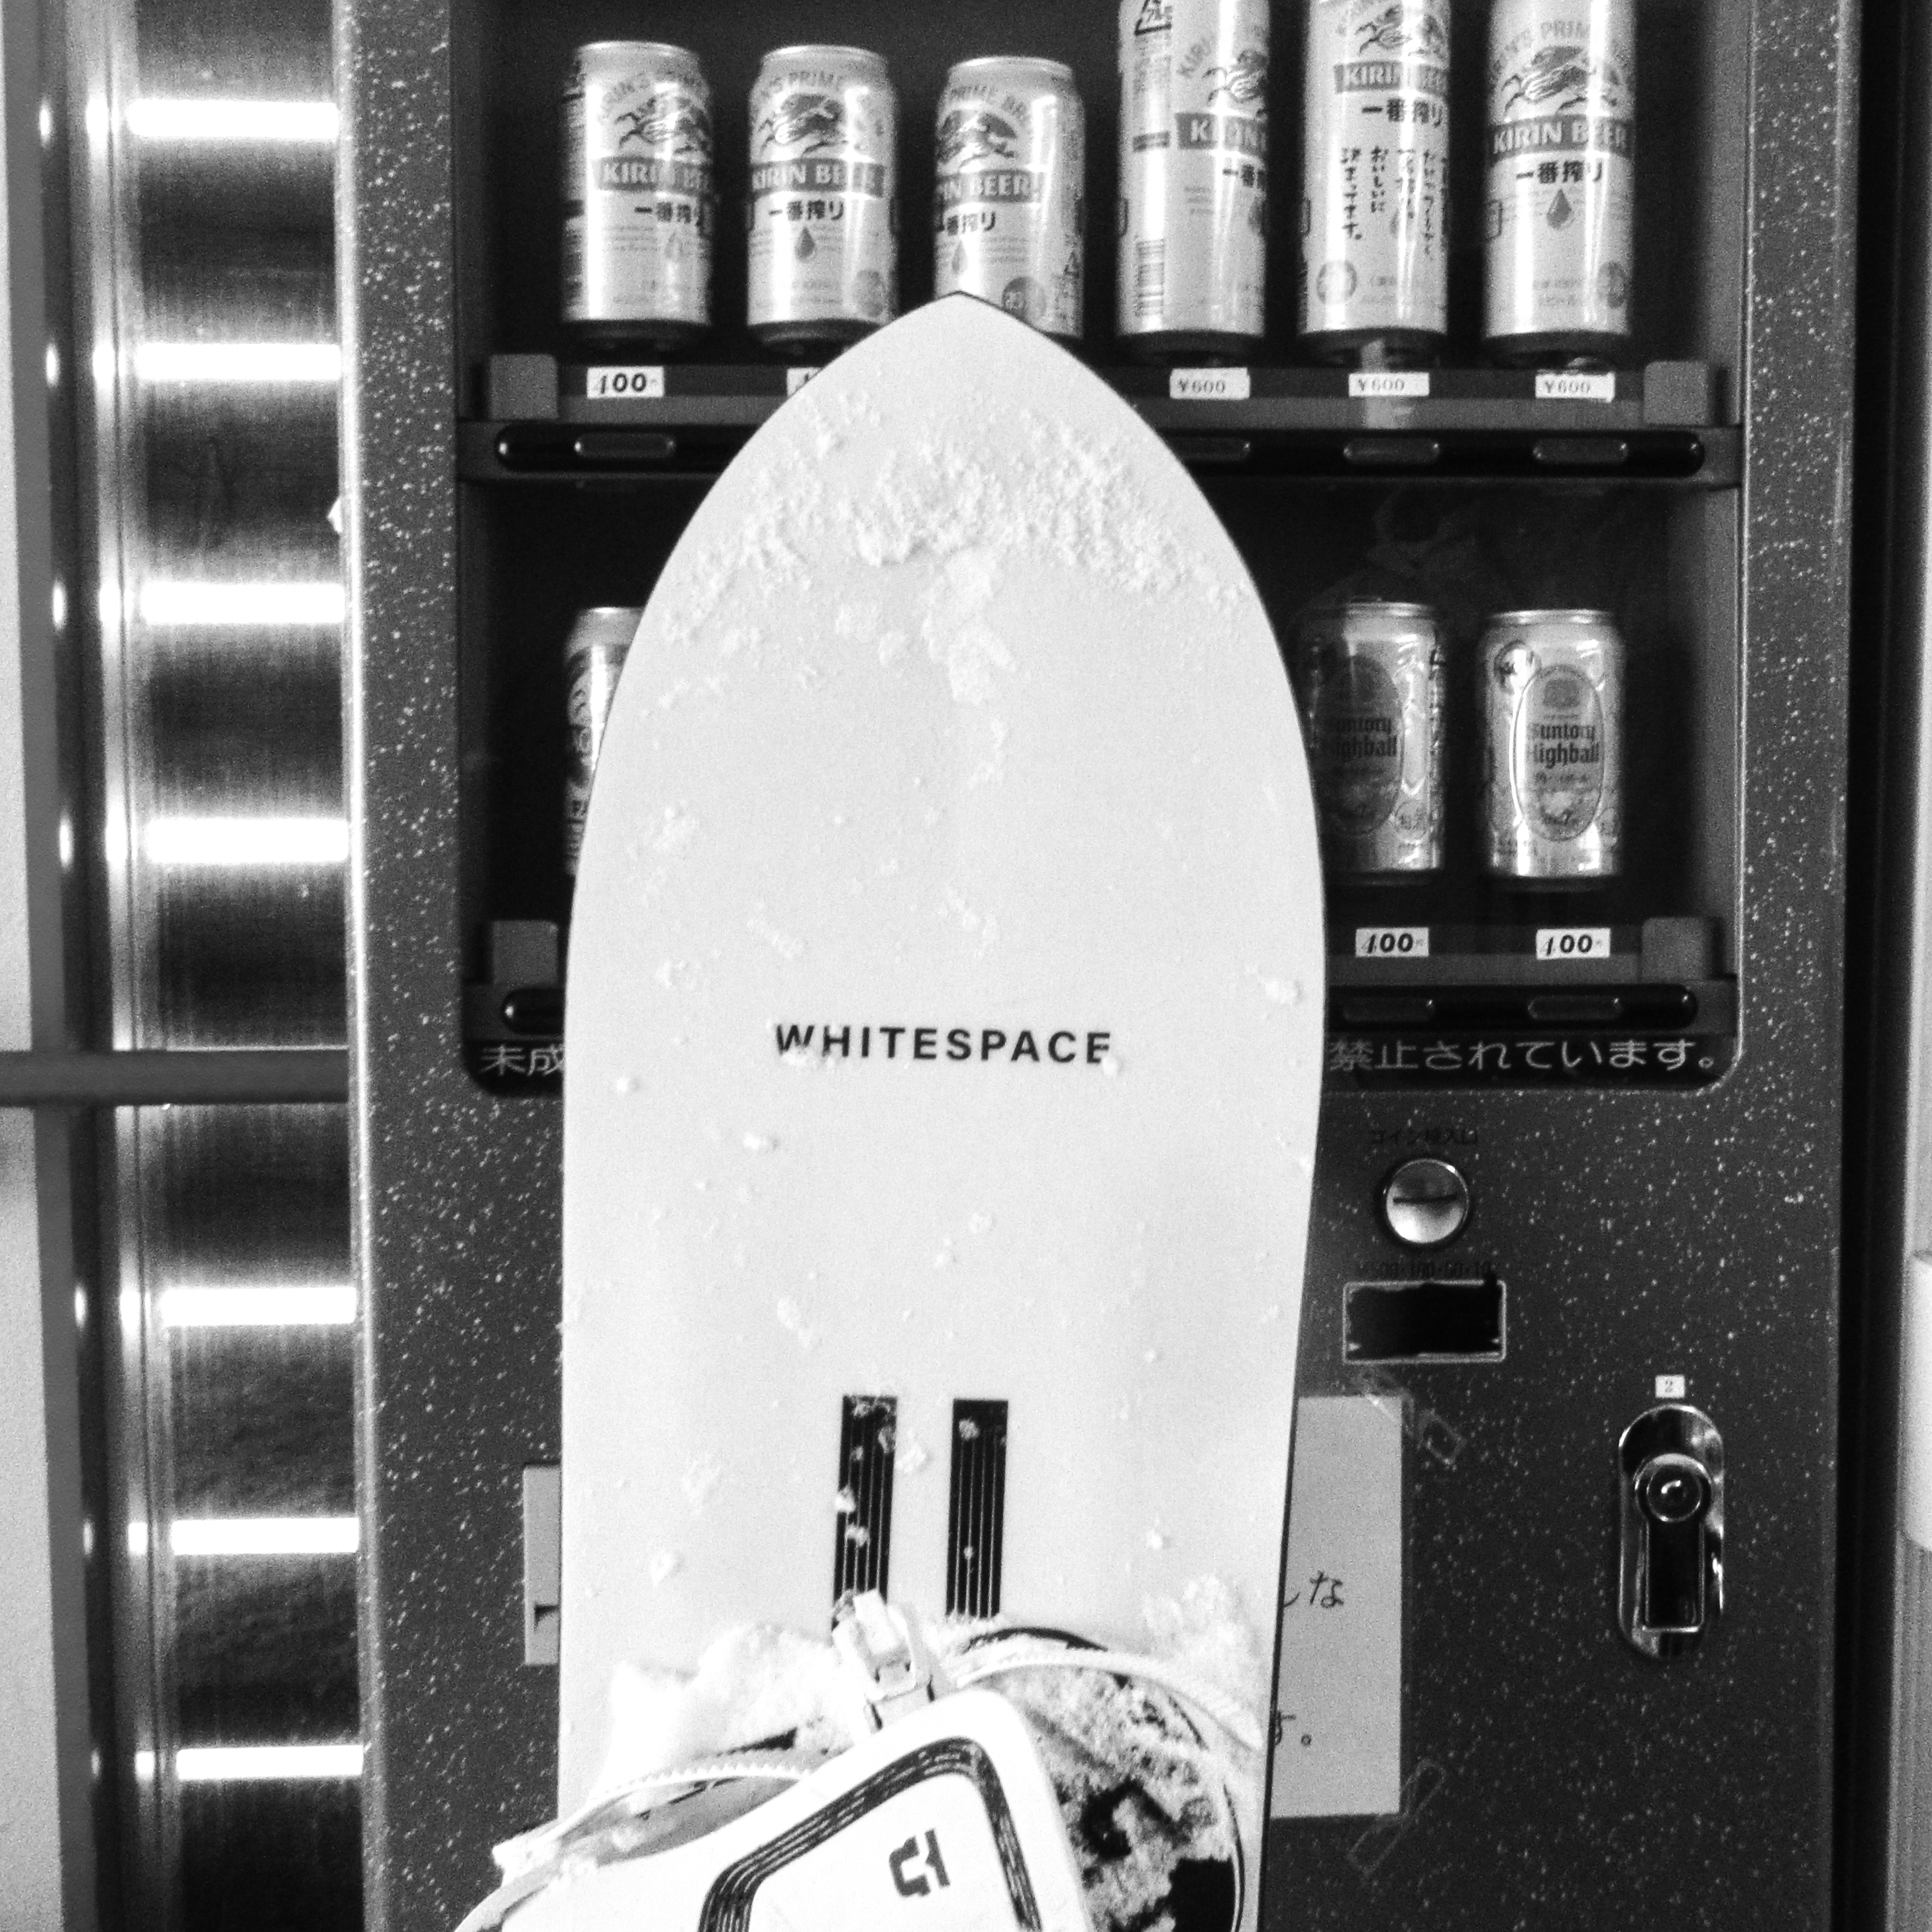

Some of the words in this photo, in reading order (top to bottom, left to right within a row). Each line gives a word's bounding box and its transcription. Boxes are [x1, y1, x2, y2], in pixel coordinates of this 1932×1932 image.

[1493, 121, 1562, 155] KIRIN
[600, 372, 647, 395] 100
[1367, 933, 1414, 954] 100
[1546, 934, 1593, 956] 100
[776, 1024, 1111, 1064] WHITESPACE
[1327, 1040, 1715, 1073] 禁止されています。
